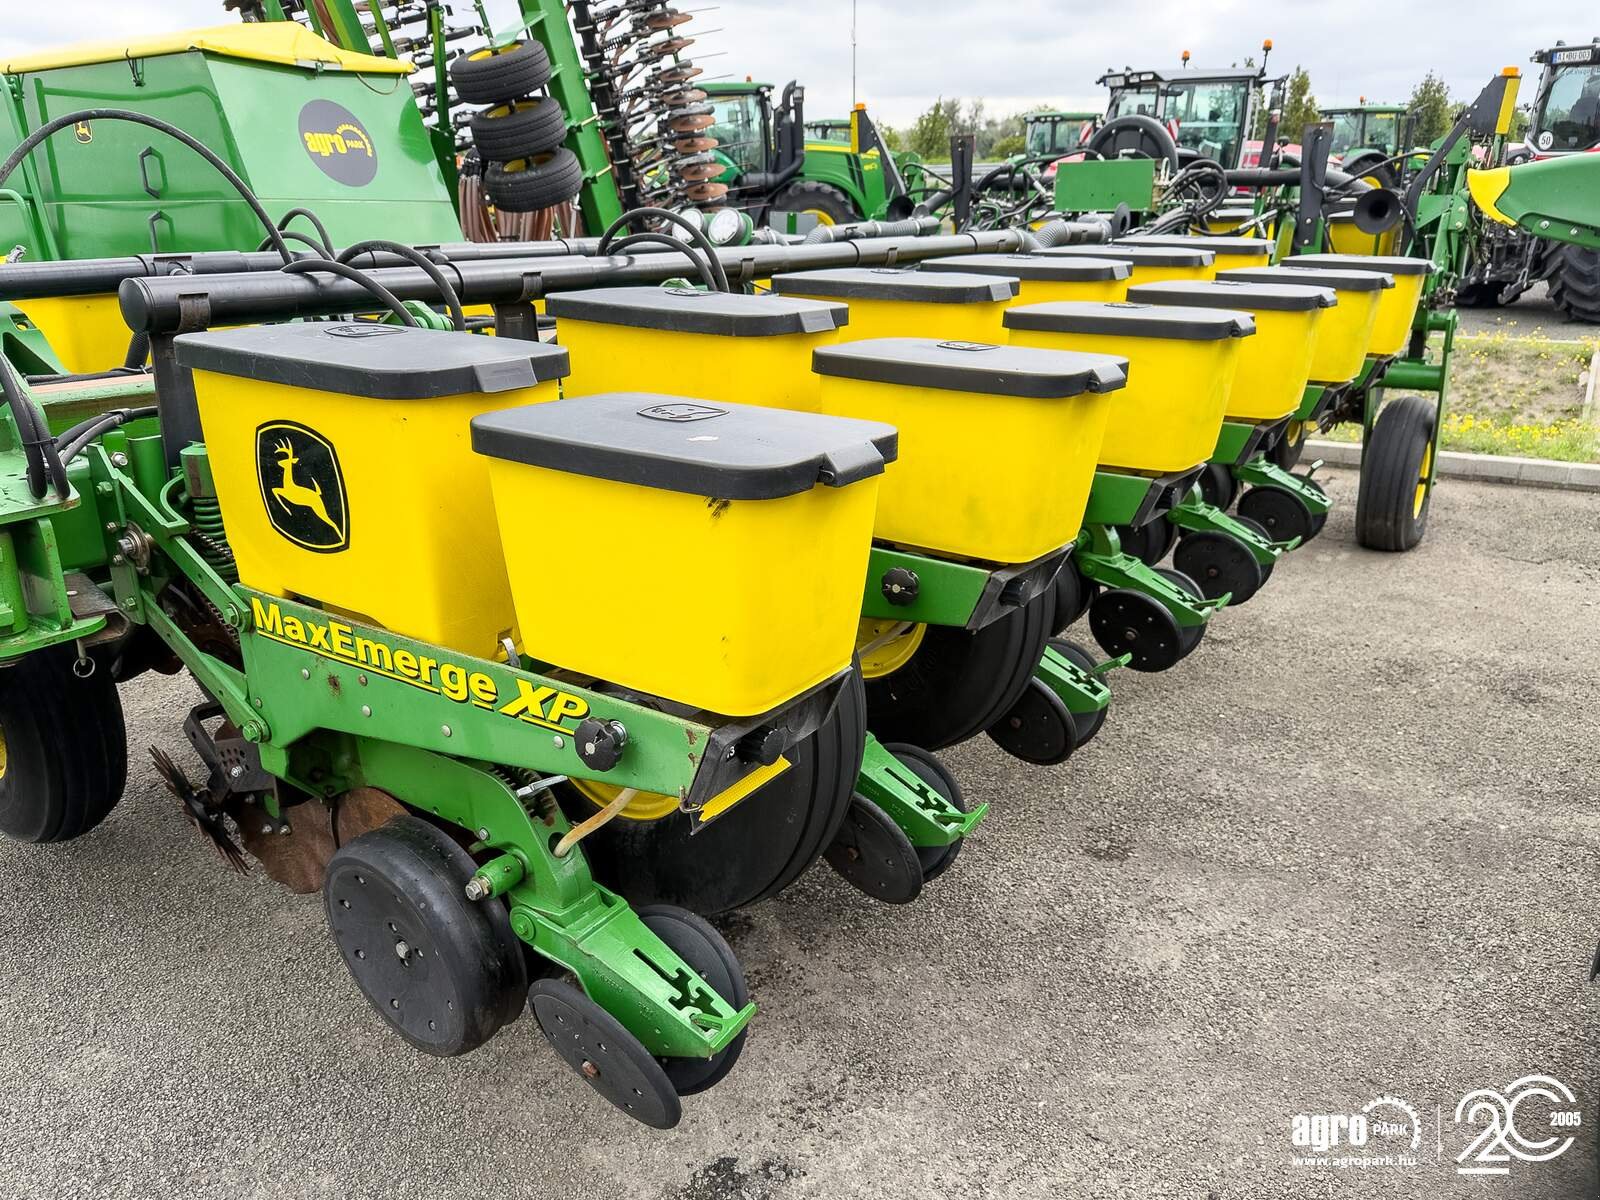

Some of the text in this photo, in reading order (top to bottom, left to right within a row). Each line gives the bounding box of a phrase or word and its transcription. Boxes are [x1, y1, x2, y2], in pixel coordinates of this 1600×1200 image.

[303, 132, 348, 157] agro
[1541, 135, 1551, 145] 50
[251, 596, 593, 725] MaxEmerge XP
